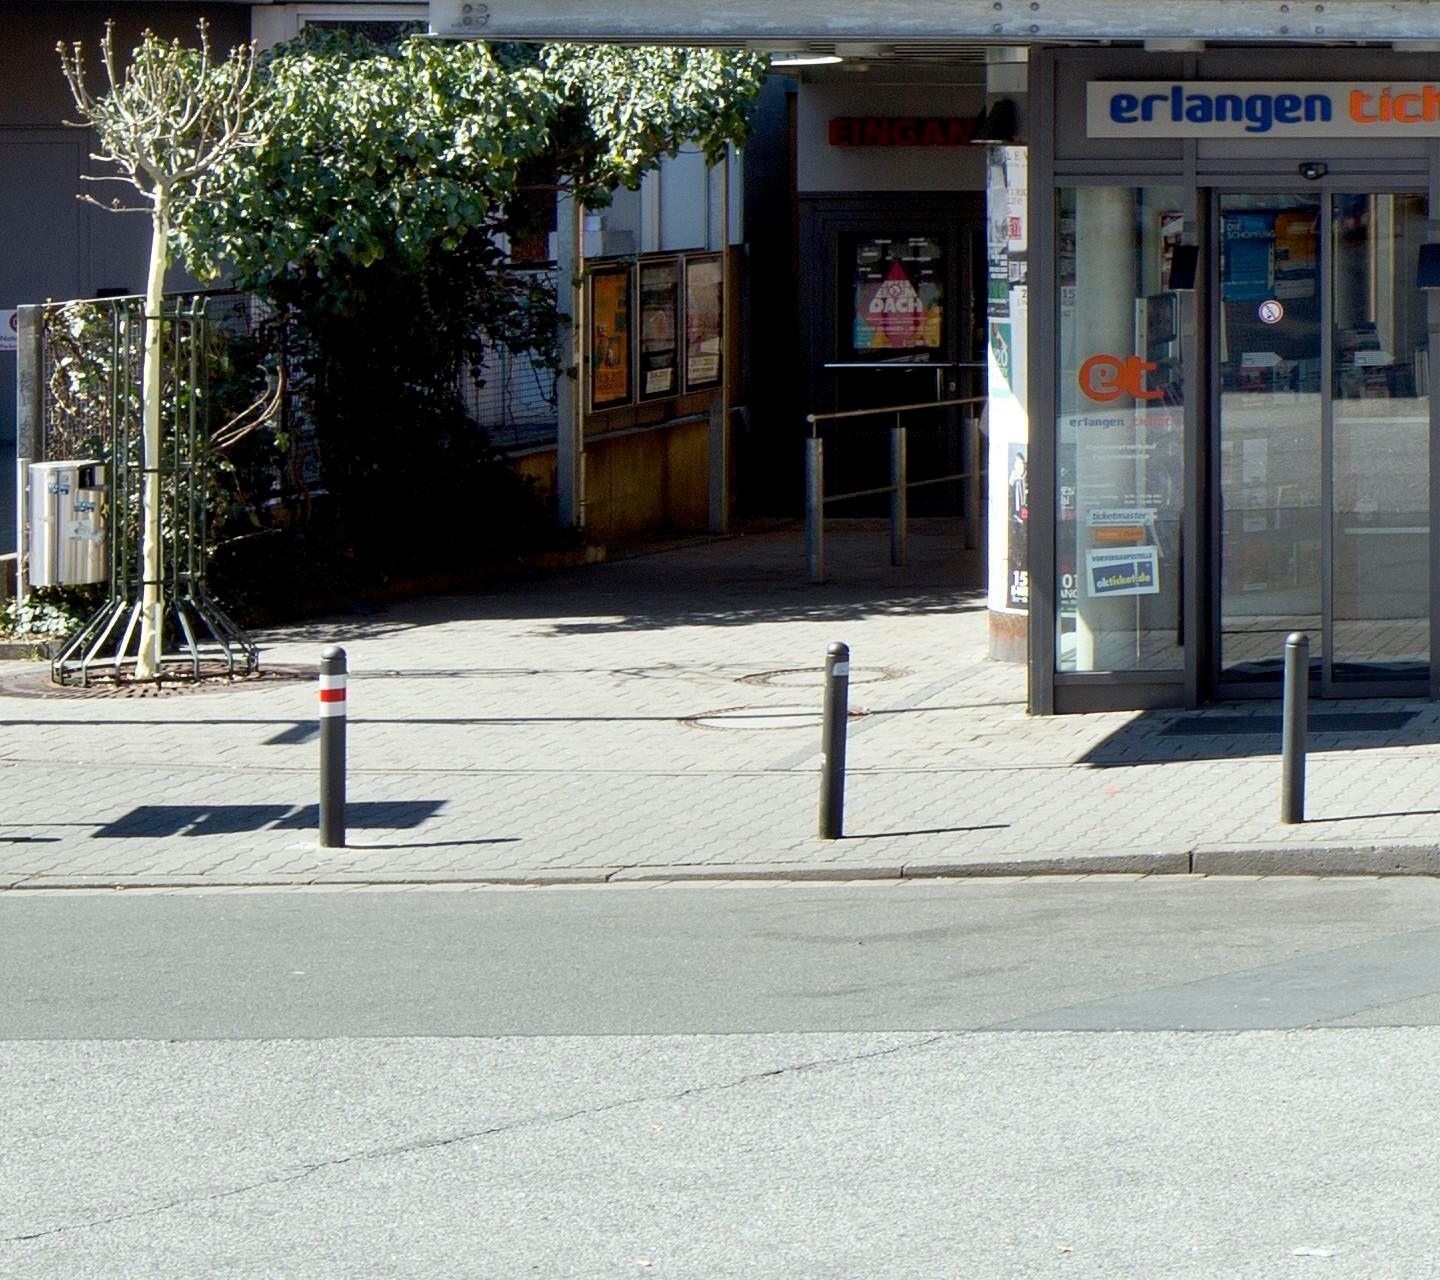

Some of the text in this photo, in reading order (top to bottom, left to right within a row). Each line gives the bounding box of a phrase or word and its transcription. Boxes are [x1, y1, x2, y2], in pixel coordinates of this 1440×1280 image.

[1109, 85, 1332, 133] erlangen
[829, 116, 978, 146] EINGAN
[869, 297, 923, 313] DACH
[1078, 354, 1164, 402] et
[1069, 417, 1125, 429] erlangen
